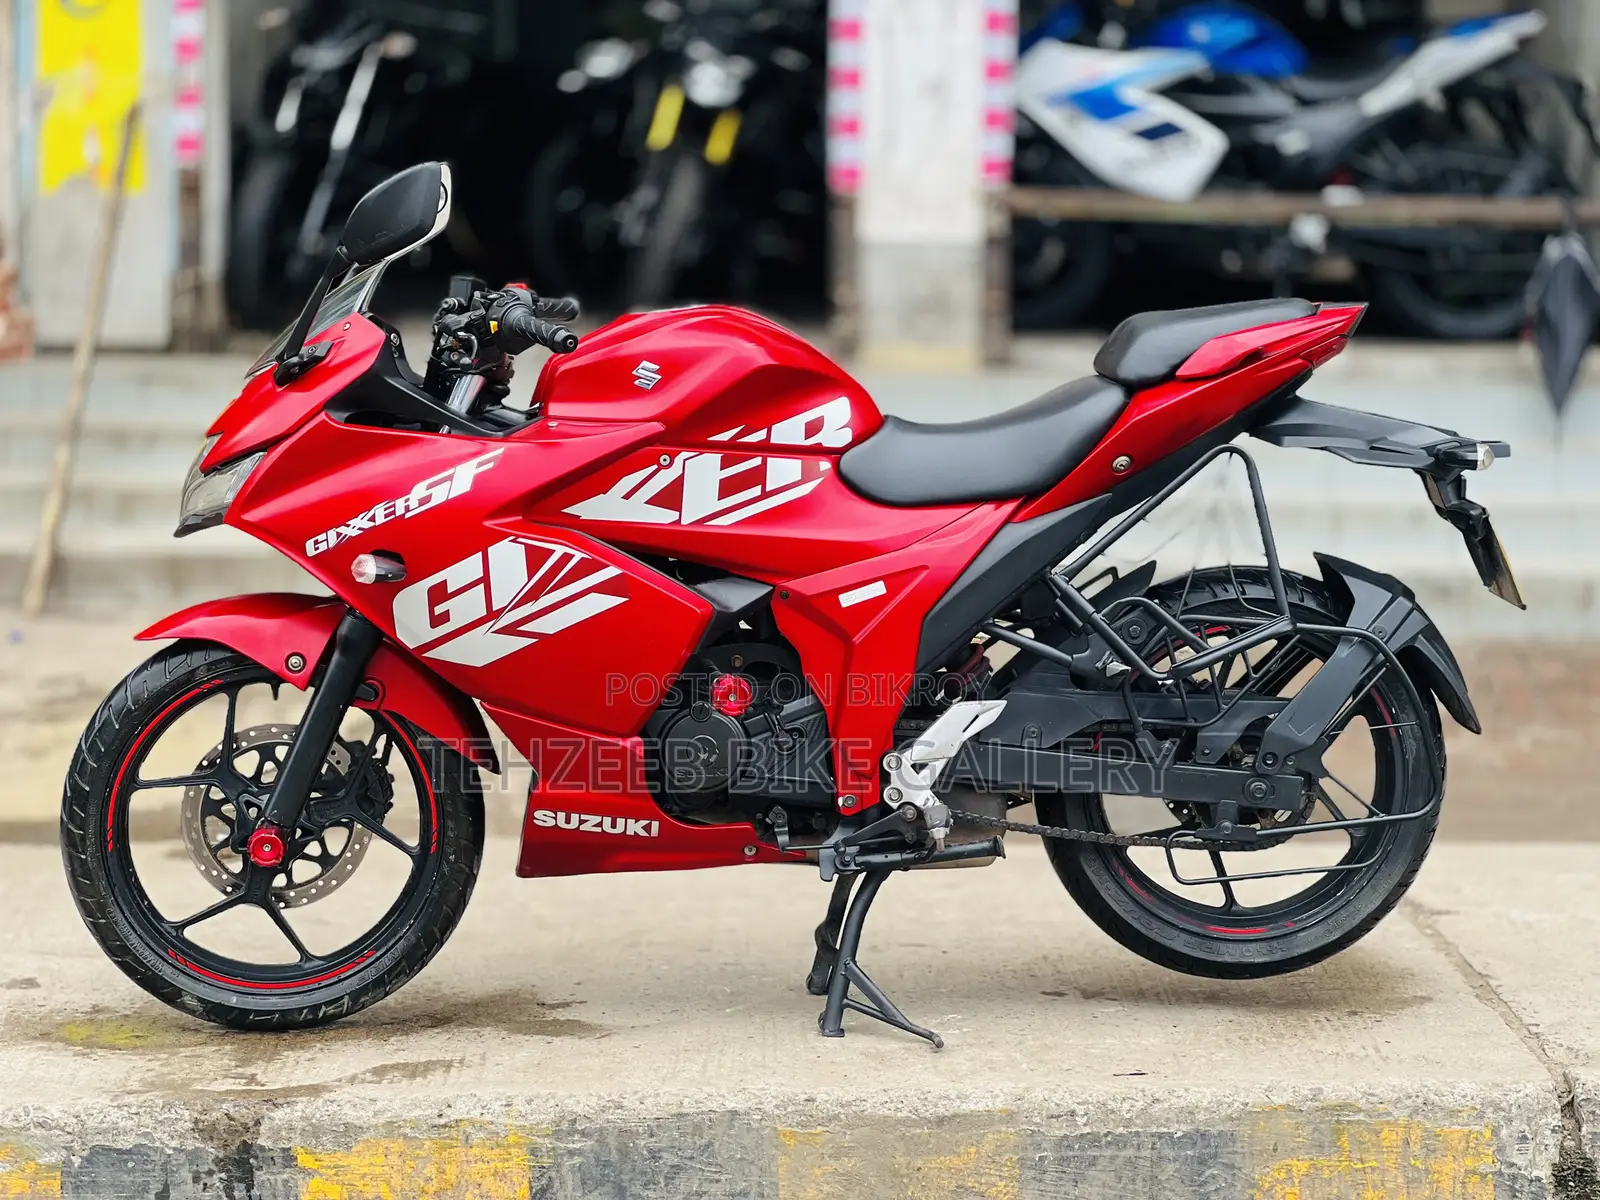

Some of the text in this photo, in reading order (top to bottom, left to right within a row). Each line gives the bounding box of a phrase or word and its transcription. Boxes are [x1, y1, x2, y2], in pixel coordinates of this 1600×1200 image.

[305, 447, 505, 557] GIXXER SF
[532, 809, 660, 838] SUZUKI
